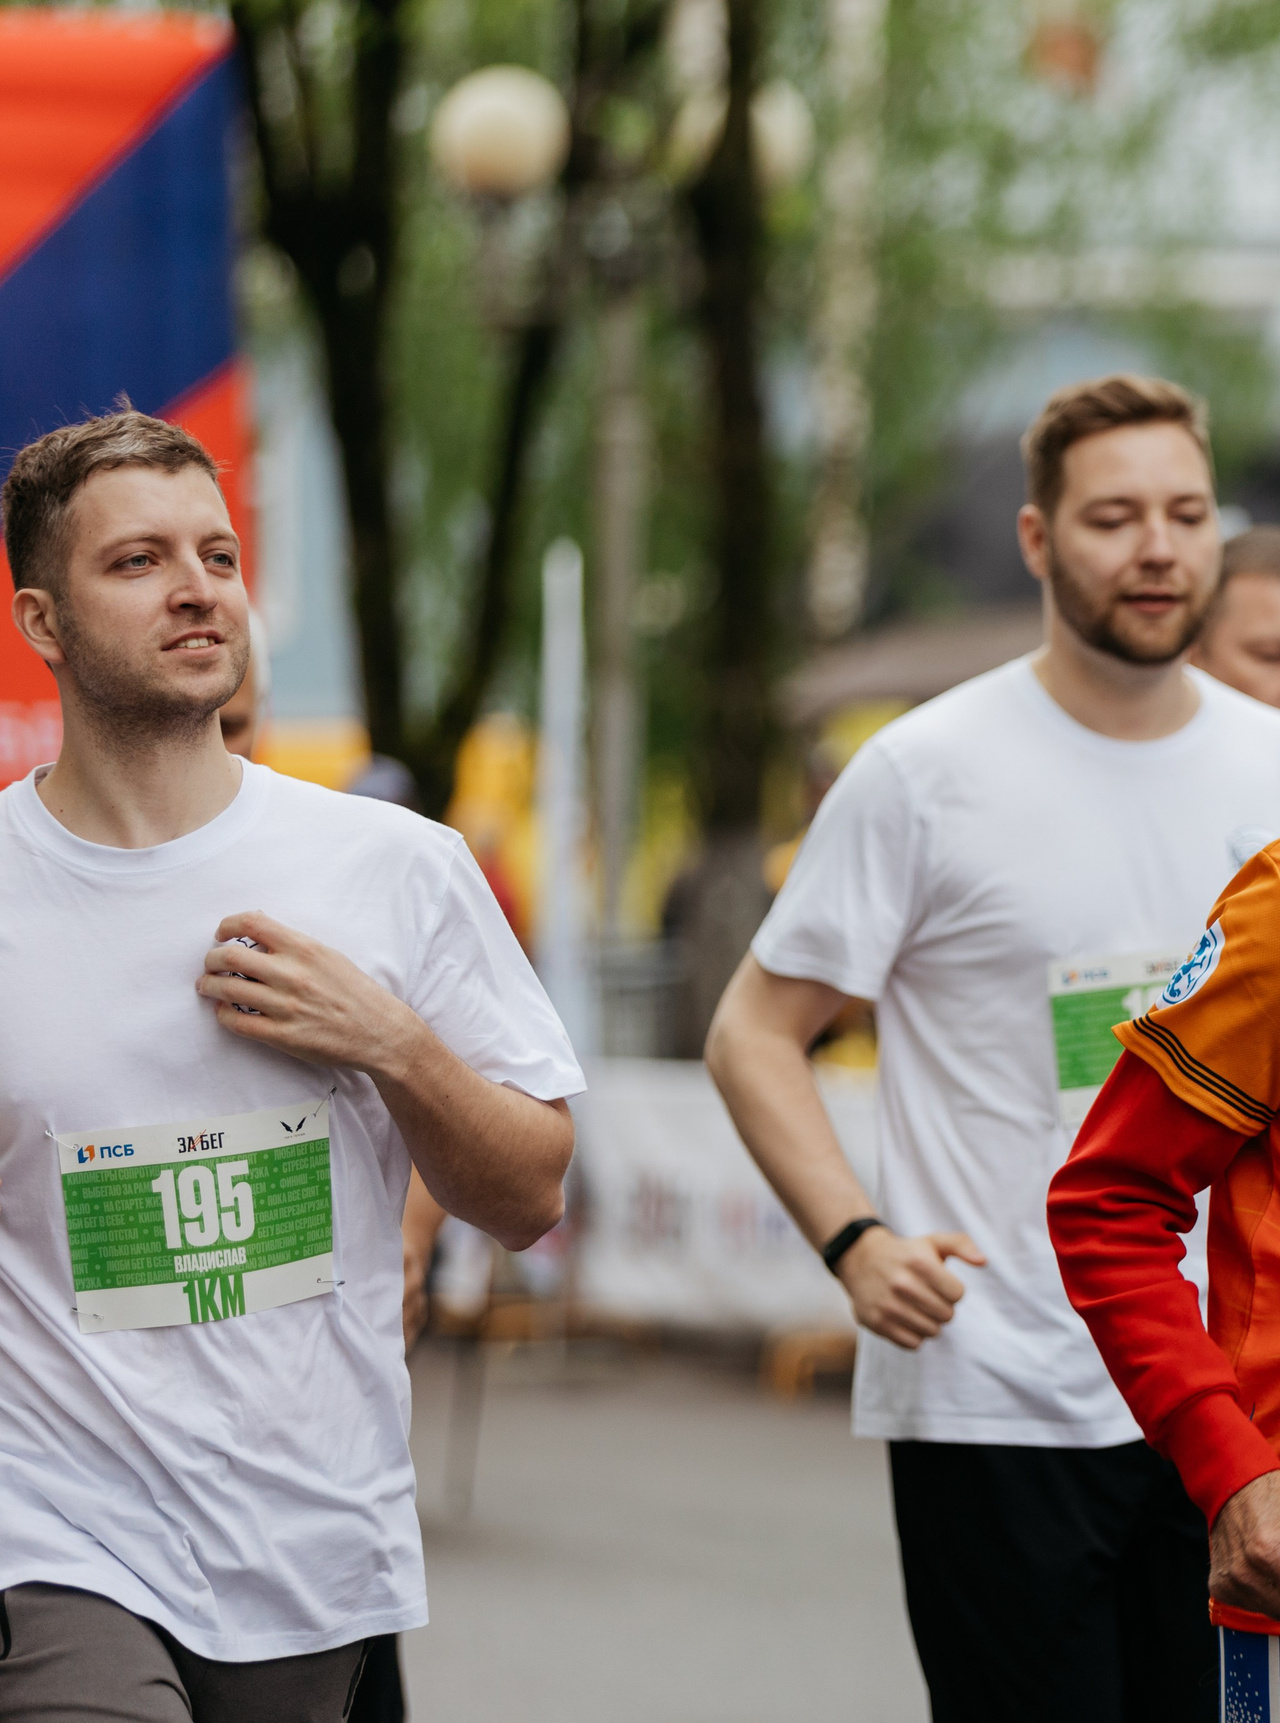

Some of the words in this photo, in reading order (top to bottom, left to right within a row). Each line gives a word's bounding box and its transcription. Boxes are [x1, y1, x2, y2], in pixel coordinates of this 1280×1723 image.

[100, 1143, 135, 1159] ПСБ
[151, 1160, 256, 1250] 195
[174, 1246, 247, 1273] ВЛАДИСЛАВ
